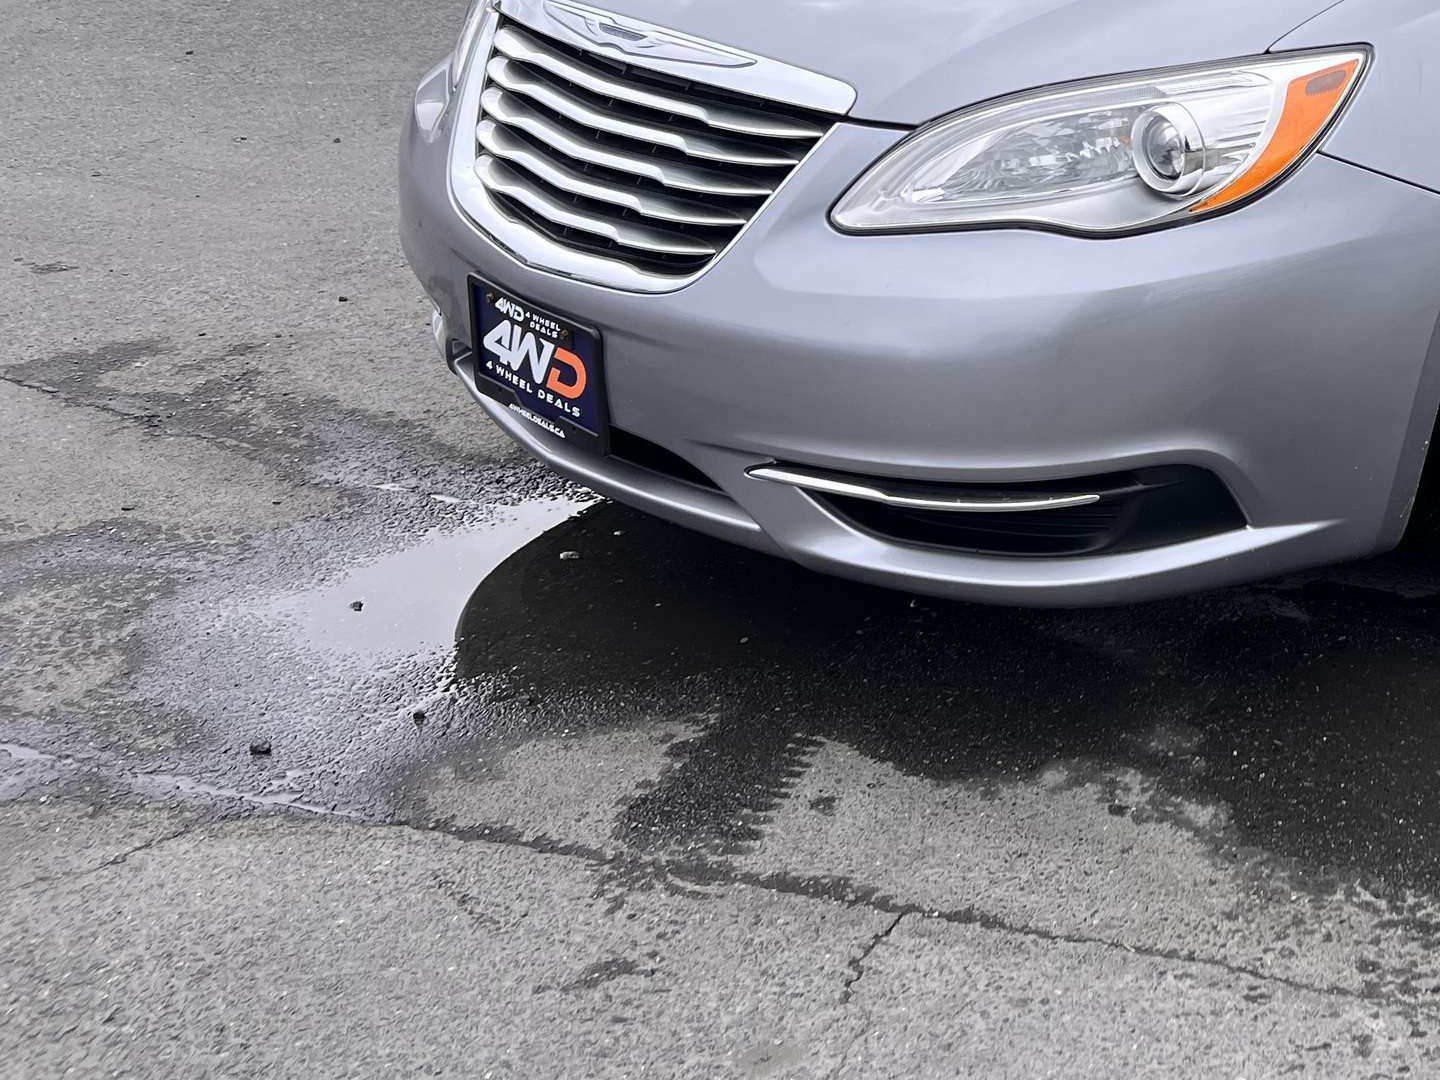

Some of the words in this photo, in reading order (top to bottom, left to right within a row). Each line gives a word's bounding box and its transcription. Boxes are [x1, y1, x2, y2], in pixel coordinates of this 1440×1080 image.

[495, 297, 524, 322] 4WD
[525, 311, 531, 319] 4
[532, 313, 561, 332] WHEEL
[529, 322, 559, 339] DEALS
[483, 319, 587, 400] 4WD
[486, 360, 493, 370] 4
[496, 365, 533, 394] WHEEL
[537, 389, 581, 418] DEALS
